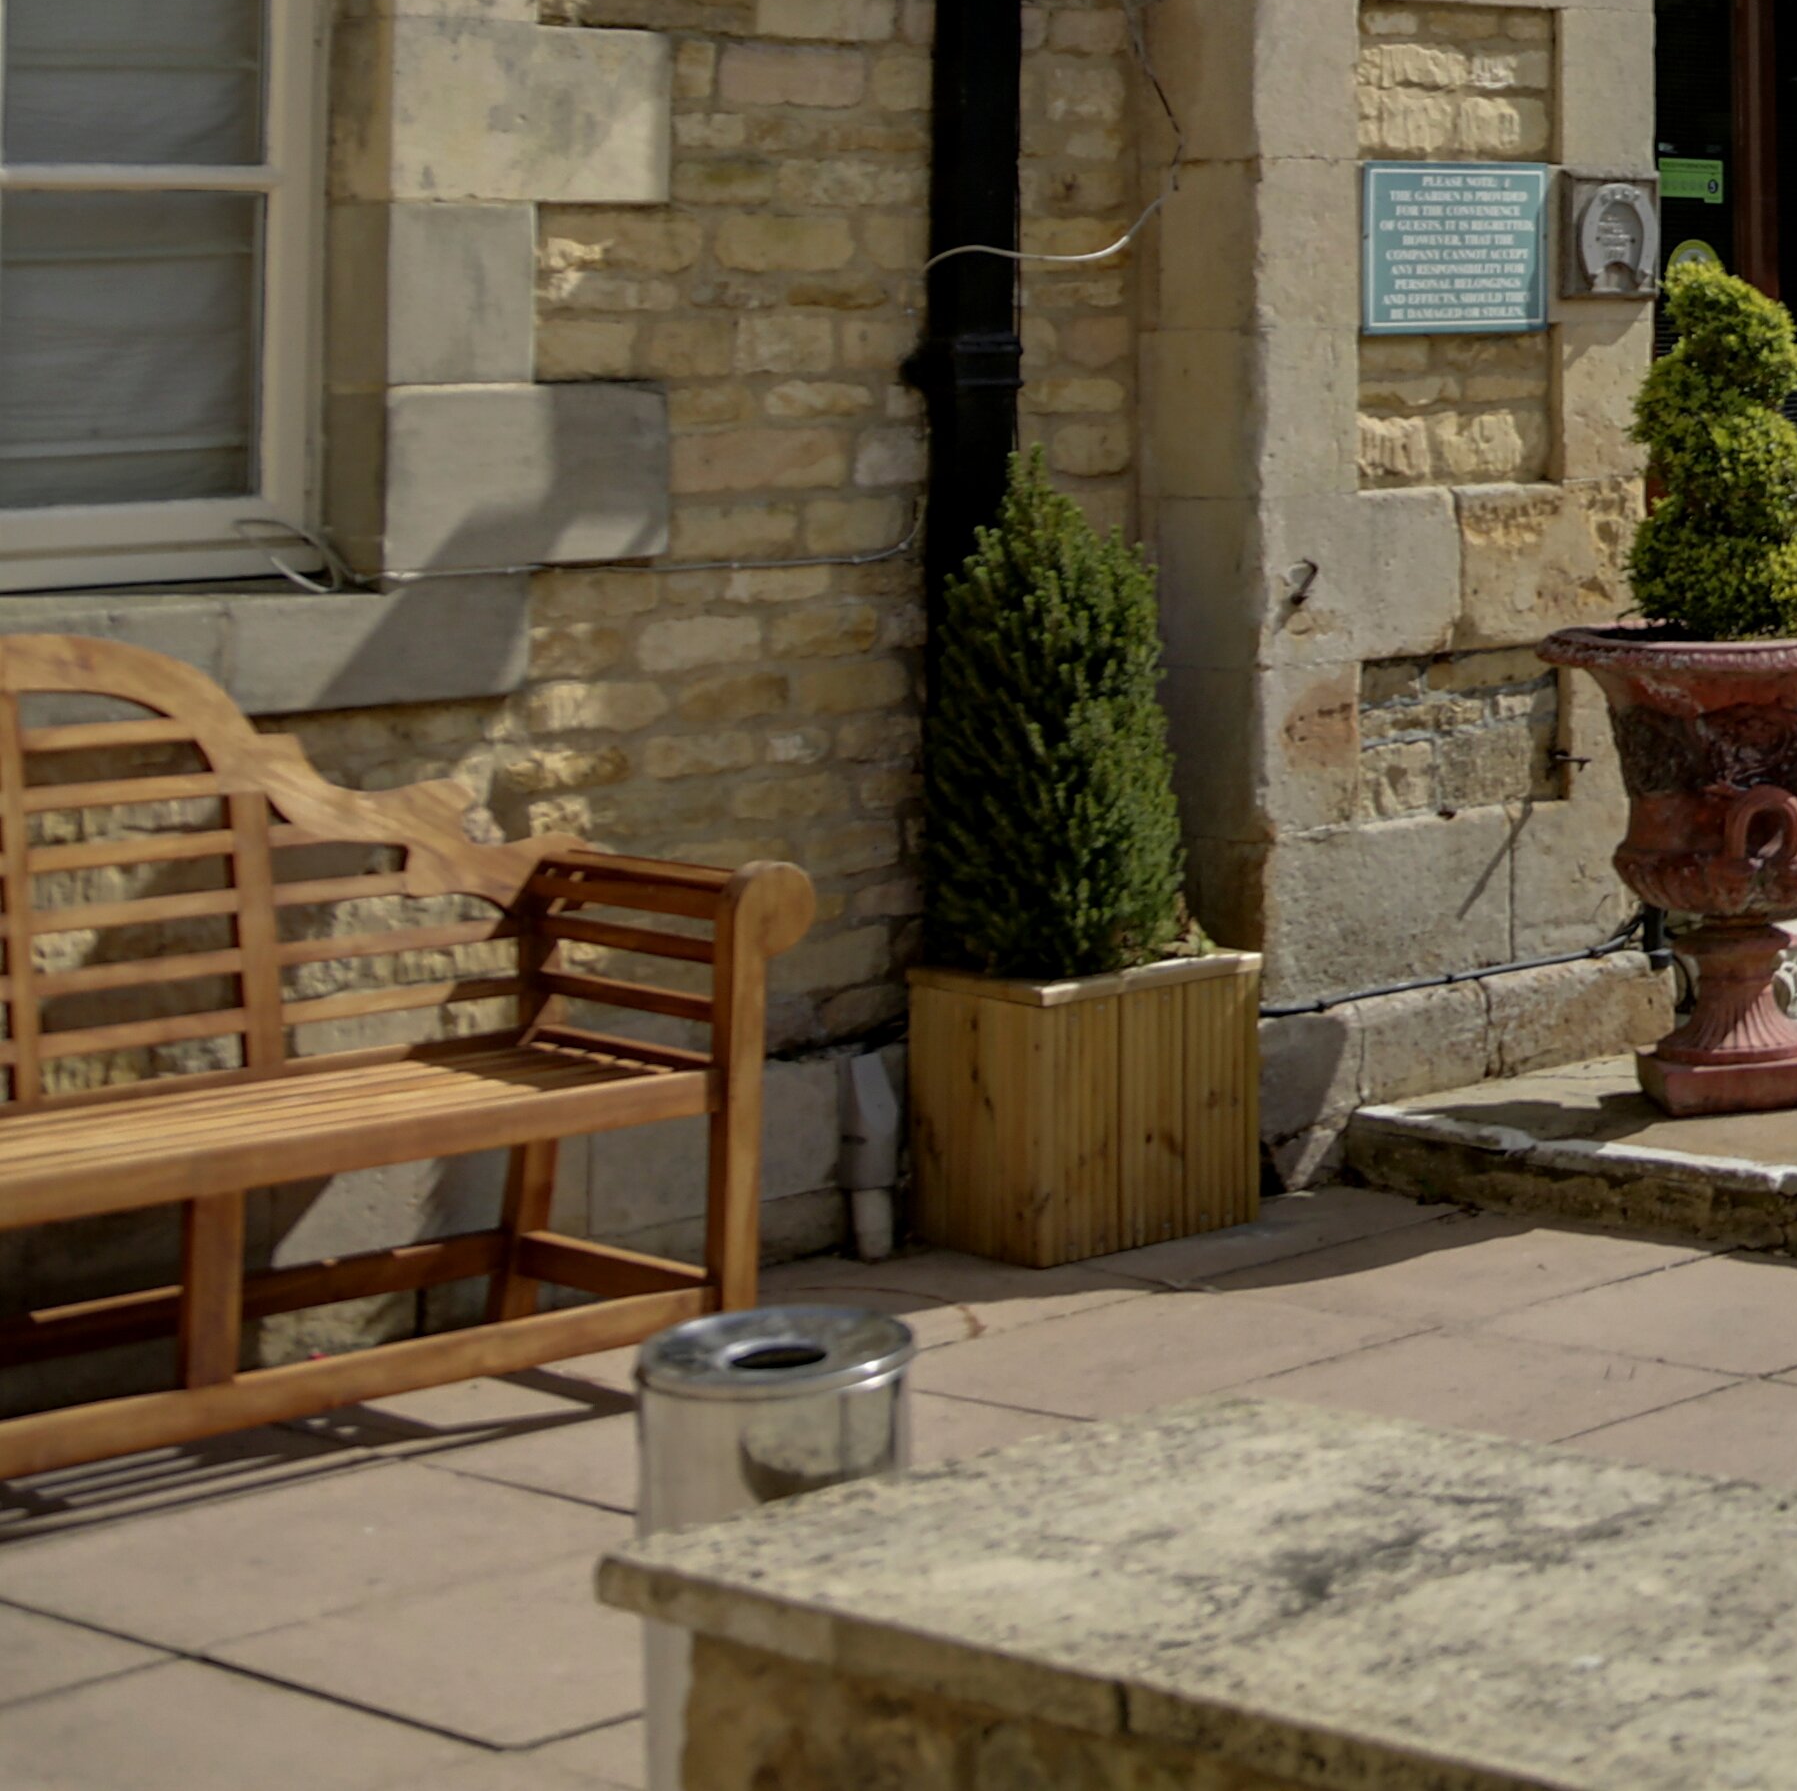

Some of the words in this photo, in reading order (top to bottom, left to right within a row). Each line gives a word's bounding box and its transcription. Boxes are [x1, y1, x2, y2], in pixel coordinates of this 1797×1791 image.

[1422, 176, 1463, 187] PLEASE
[1390, 190, 1411, 201] THE
[1415, 190, 1460, 201] GARDEN
[1463, 190, 1472, 201] IS
[1475, 190, 1528, 201] PROVIDED
[1396, 205, 1419, 216] FOR
[1422, 205, 1443, 216] THE
[1446, 205, 1521, 216] CONVENIENCE
[1464, 234, 1492, 245] THAT
[1495, 234, 1514, 245] THE
[1385, 249, 1440, 260] COMPANY
[1442, 249, 1487, 260] CANNOT
[1490, 249, 1528, 260] ACCEPT
[1391, 263, 1413, 275] ANY
[1416, 263, 1502, 275] RESPONSIBILITY
[1504, 263, 1525, 275] FOR
[1395, 278, 1451, 289] PERSONAL
[1454, 278, 1521, 289] BELONGINGS
[1383, 294, 1406, 305] AND
[1460, 292, 1503, 304] SHOULD
[1390, 308, 1404, 319] BE
[1407, 308, 1463, 319] DAMAGED
[1465, 307, 1480, 319] OR
